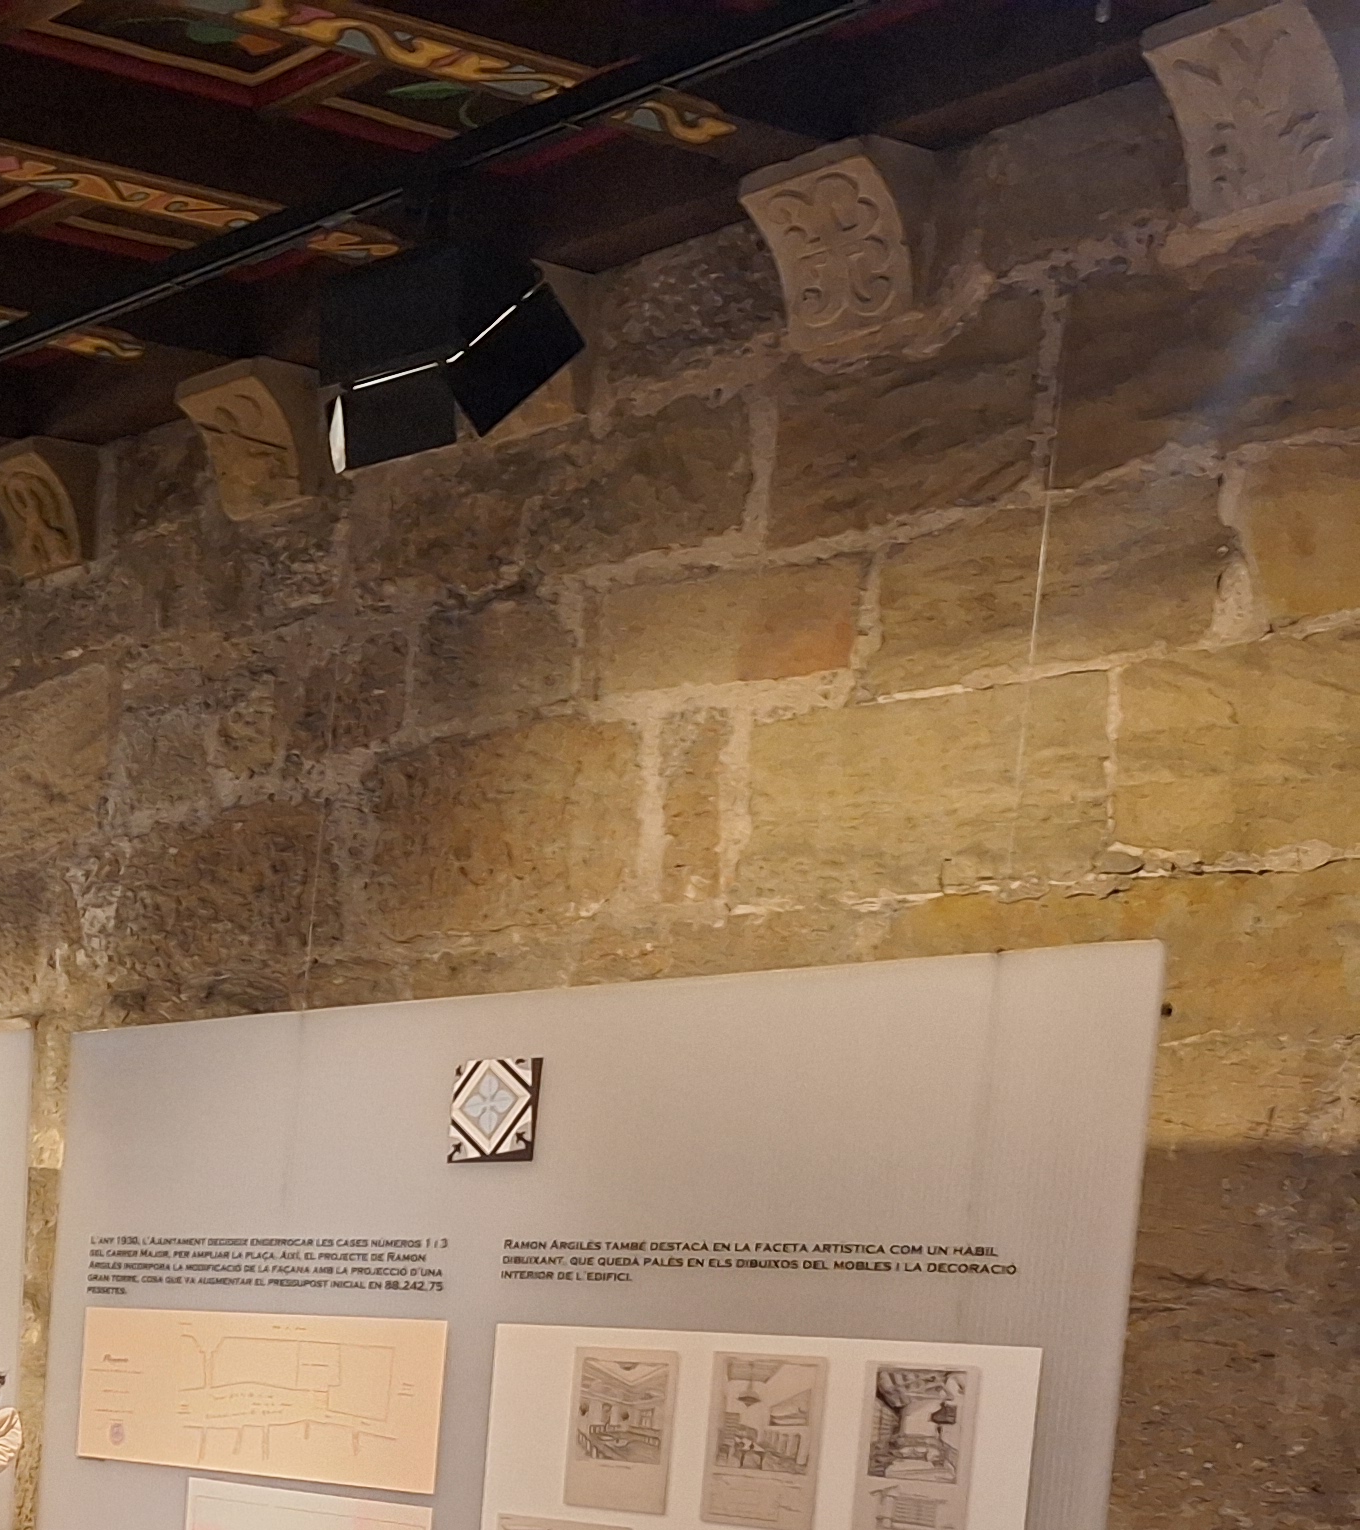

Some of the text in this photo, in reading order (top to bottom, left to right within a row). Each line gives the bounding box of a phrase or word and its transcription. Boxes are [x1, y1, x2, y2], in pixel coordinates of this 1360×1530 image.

[316, 1239, 334, 1247] LES
[441, 1238, 448, 1248] 3
[504, 1239, 547, 1250] RAMON
[713, 1243, 730, 1251] EN
[735, 1243, 751, 1252] LA
[755, 1243, 808, 1253] FACETA
[890, 1245, 923, 1255] COM
[927, 1246, 948, 1255] UN
[304, 1252, 316, 1260] EL
[318, 1253, 368, 1261] PROJECTE
[387, 1252, 426, 1262] RAMON
[570, 1257, 594, 1266] QUE
[687, 1258, 704, 1267] EN
[709, 1259, 732, 1268] ELS
[736, 1259, 798, 1269] DIBUIXOS
[803, 1260, 829, 1270] DEL
[834, 1261, 891, 1271] MOBLES
[904, 1263, 922, 1272] LA
[927, 1263, 1016, 1275] DECORACIÓ
[351, 1267, 407, 1276] PROJECCIÓ
[501, 1271, 554, 1279] INTERIOR
[557, 1272, 573, 1281] DE
[368, 1281, 382, 1289] EN
